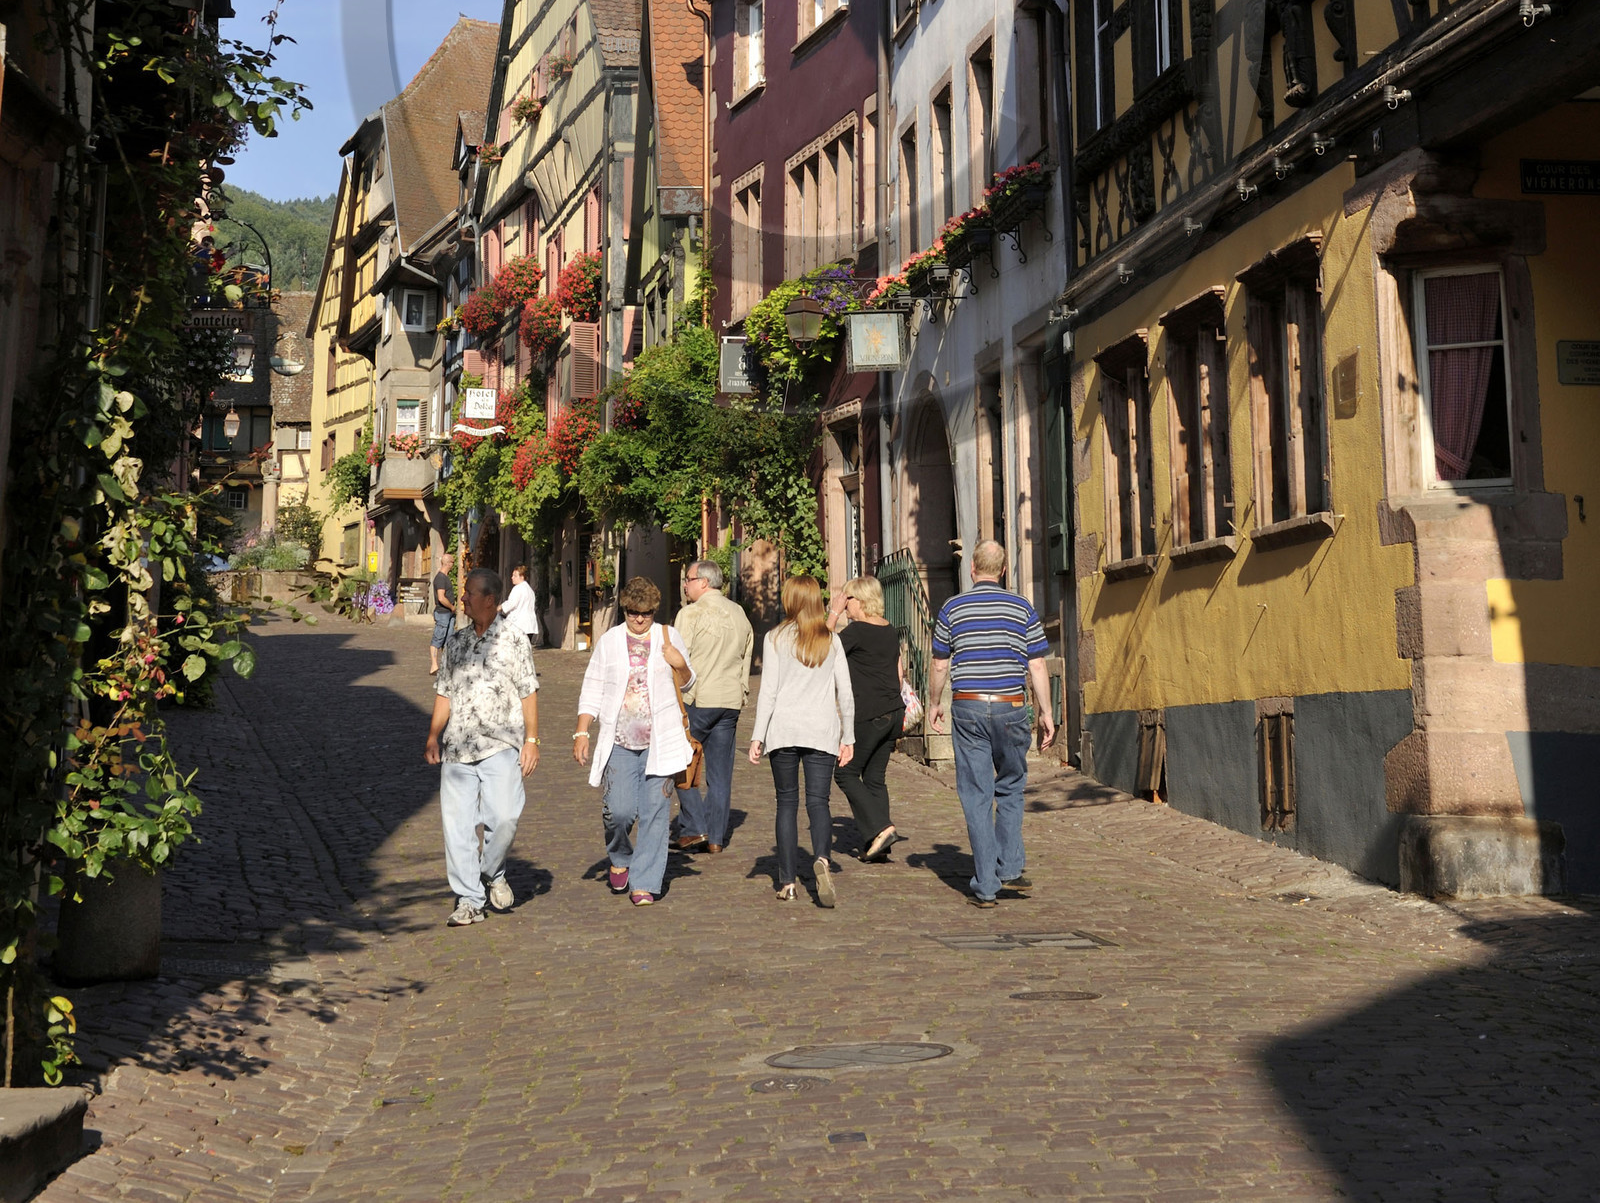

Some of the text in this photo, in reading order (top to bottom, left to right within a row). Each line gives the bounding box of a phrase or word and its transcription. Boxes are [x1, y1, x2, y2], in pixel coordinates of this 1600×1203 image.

[1536, 164, 1591, 175] COUR DES
[1525, 176, 1600, 191] VIGNERONS
[181, 314, 244, 327] Coutelier
